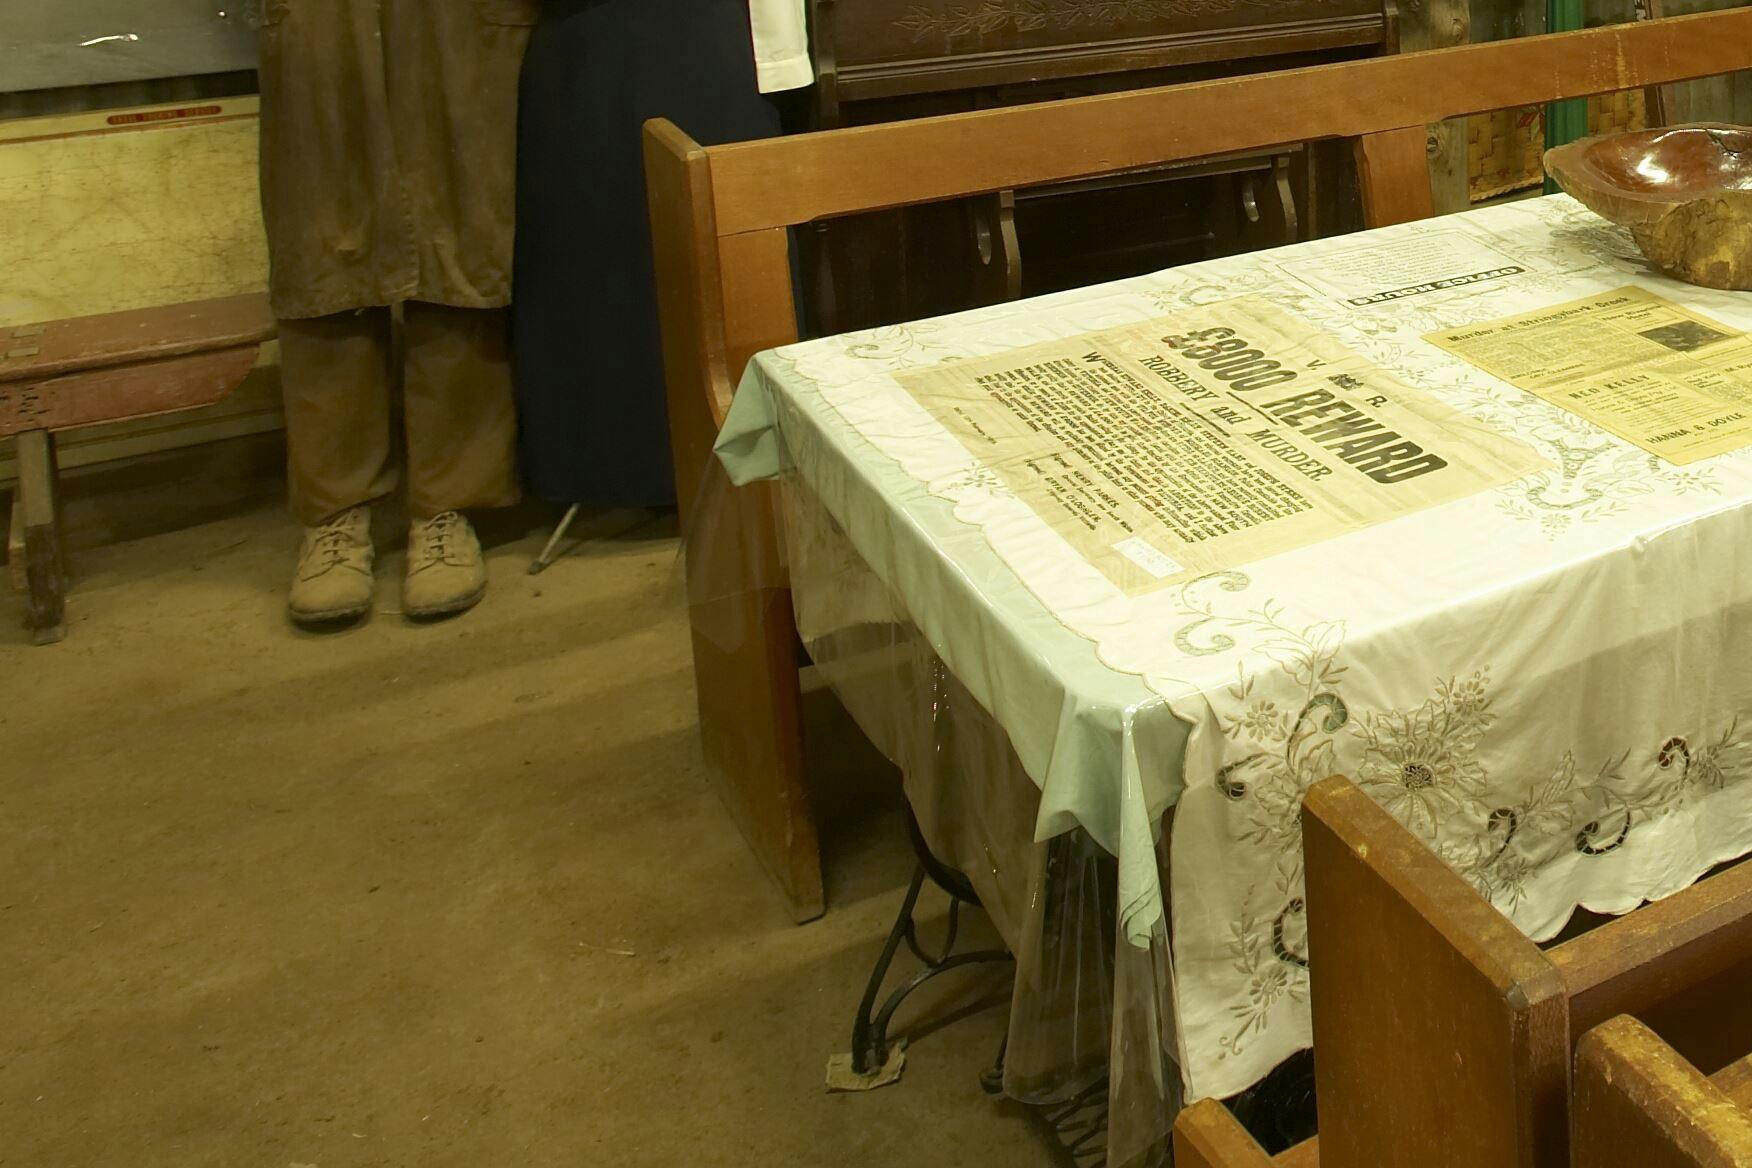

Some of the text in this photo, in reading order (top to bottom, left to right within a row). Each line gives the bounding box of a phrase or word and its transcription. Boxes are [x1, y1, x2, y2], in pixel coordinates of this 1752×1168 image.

[1355, 267, 1519, 306] OFFICE HOURS
[1446, 296, 1629, 343] Murder at Stringybark Creek
[1138, 354, 1221, 402] ROBBERY
[1209, 405, 1252, 426] and
[1161, 326, 1298, 392] £8000
[1260, 387, 1449, 484] REWARD
[1365, 395, 1388, 409] R.
[1567, 373, 1652, 401] NED KELLY
[1646, 412, 1747, 445] HANNA & DOYLE
